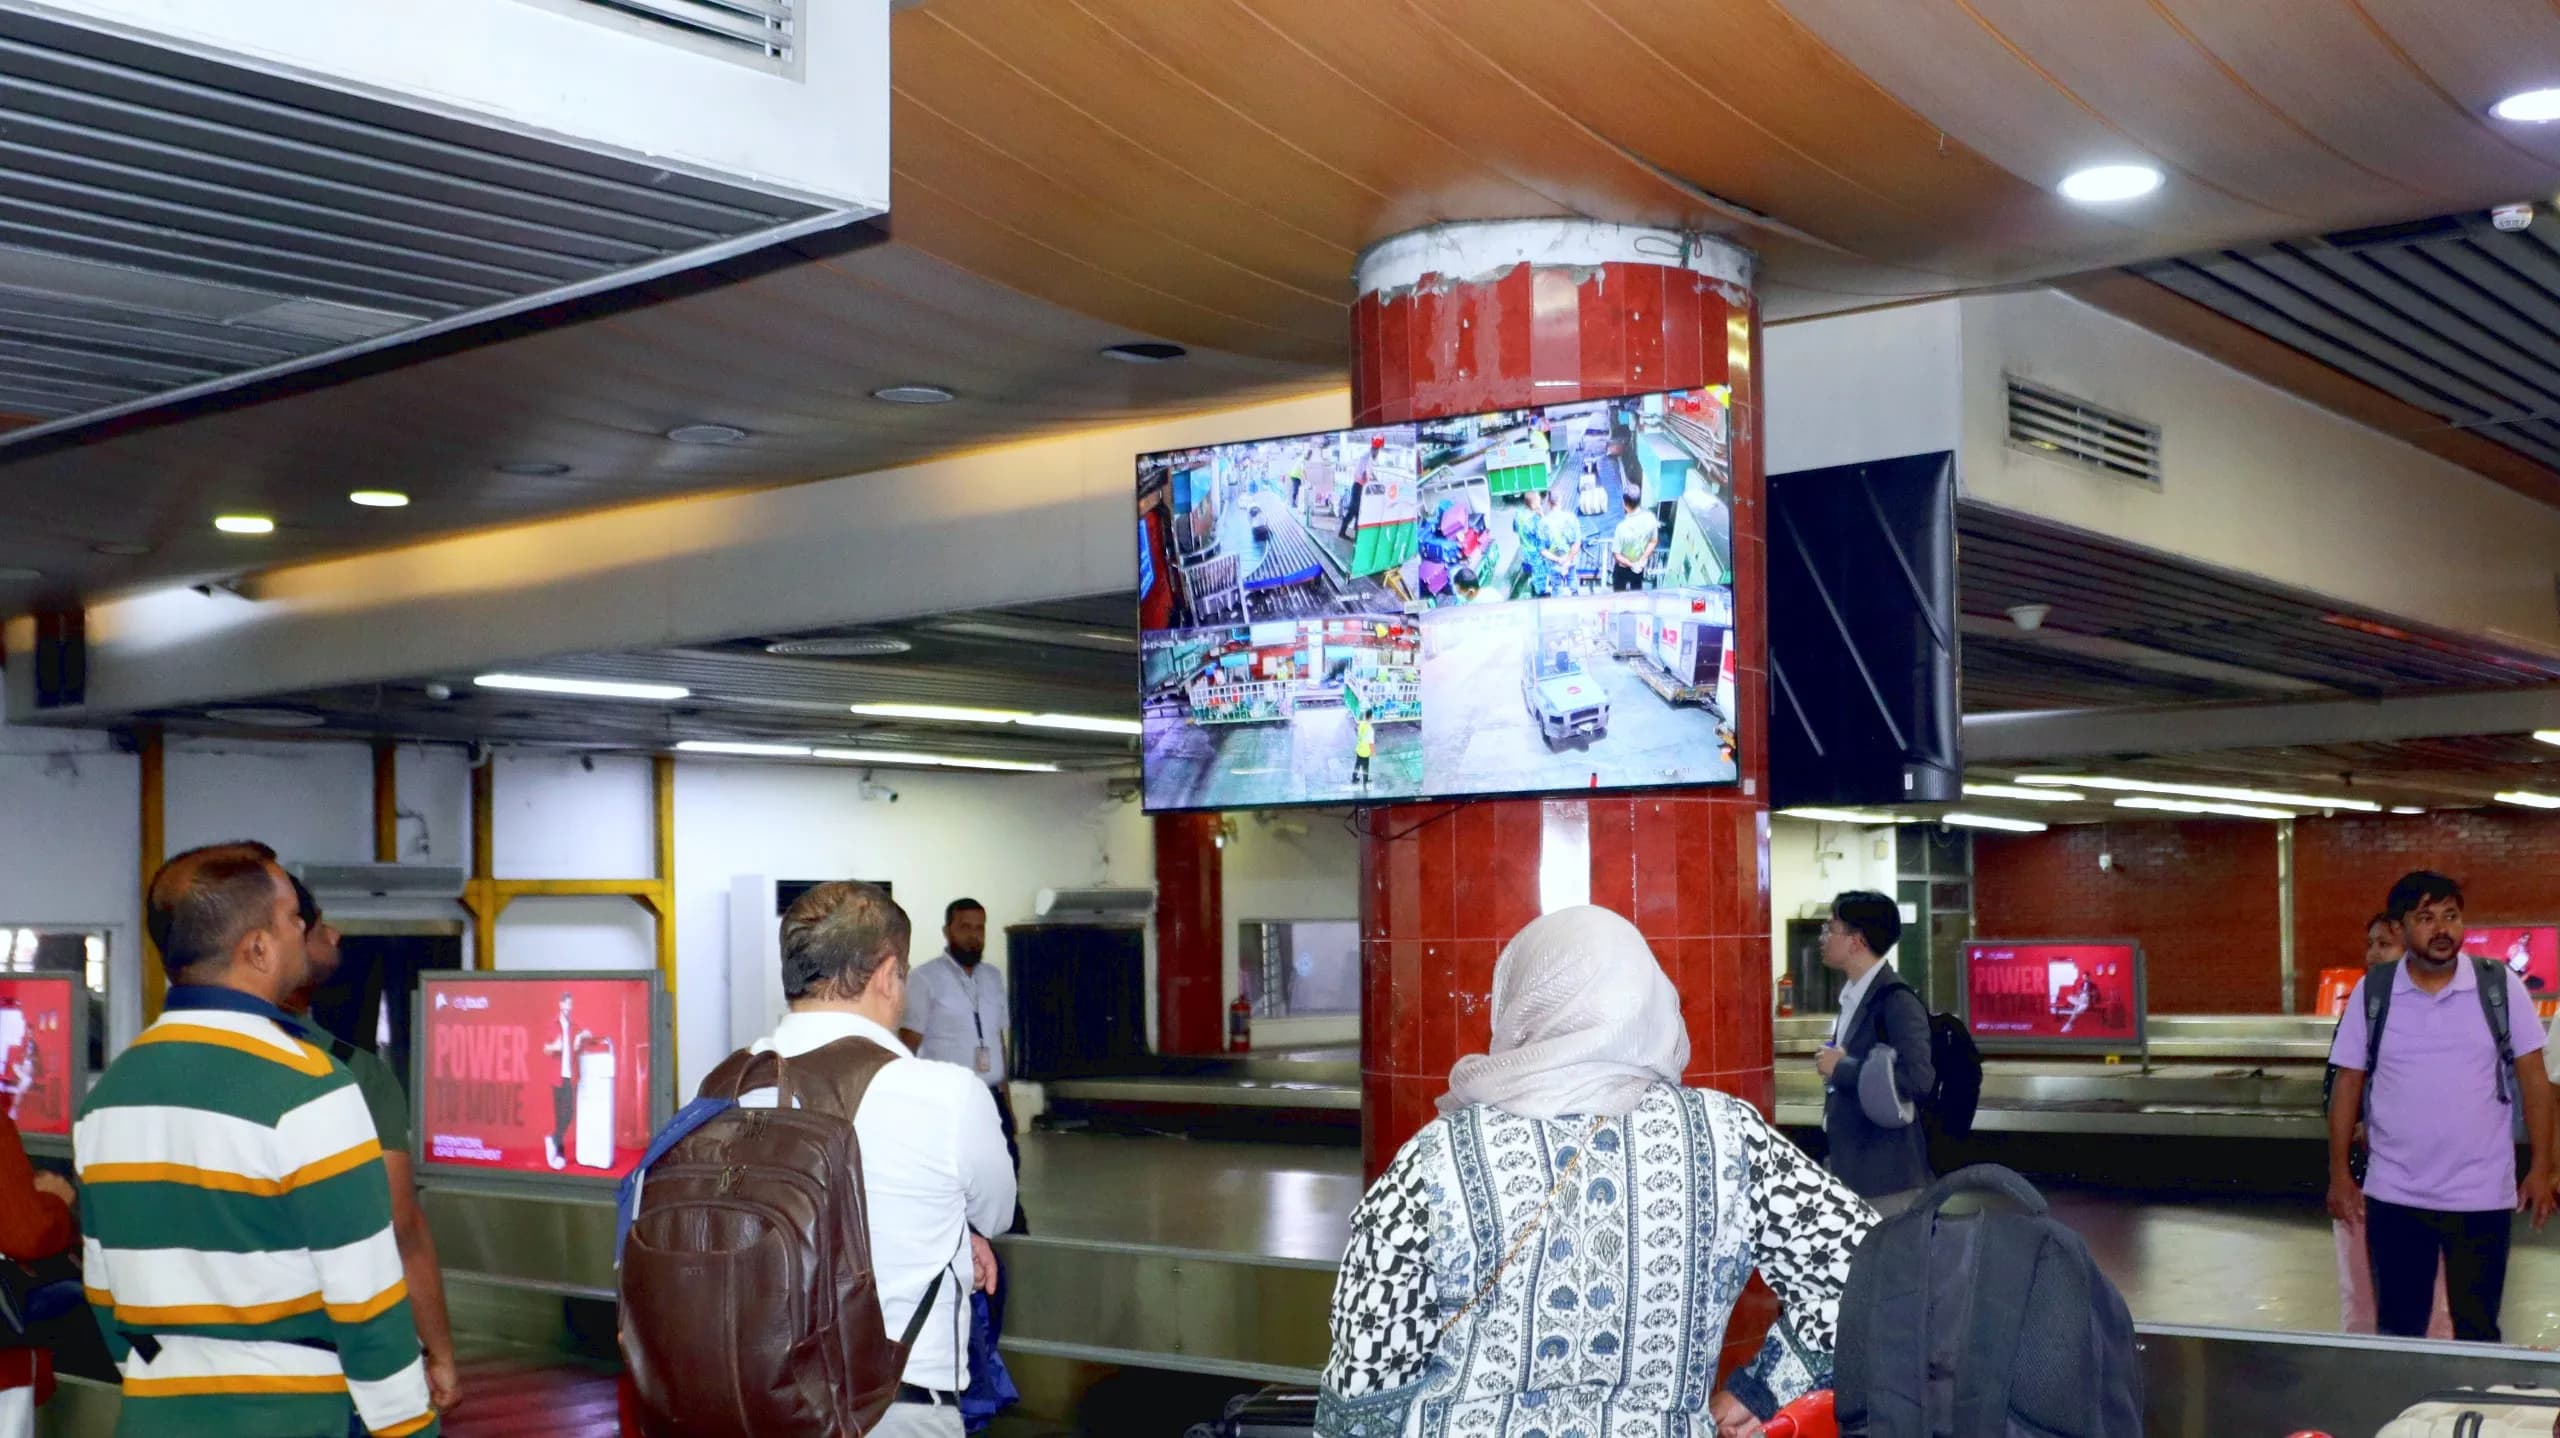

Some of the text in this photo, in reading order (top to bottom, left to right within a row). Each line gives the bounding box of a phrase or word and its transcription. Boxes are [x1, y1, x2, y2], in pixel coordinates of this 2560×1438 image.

[1975, 966, 2046, 994] POWER
[434, 1024, 530, 1082] POWER
[464, 1082, 525, 1128] MOVE
